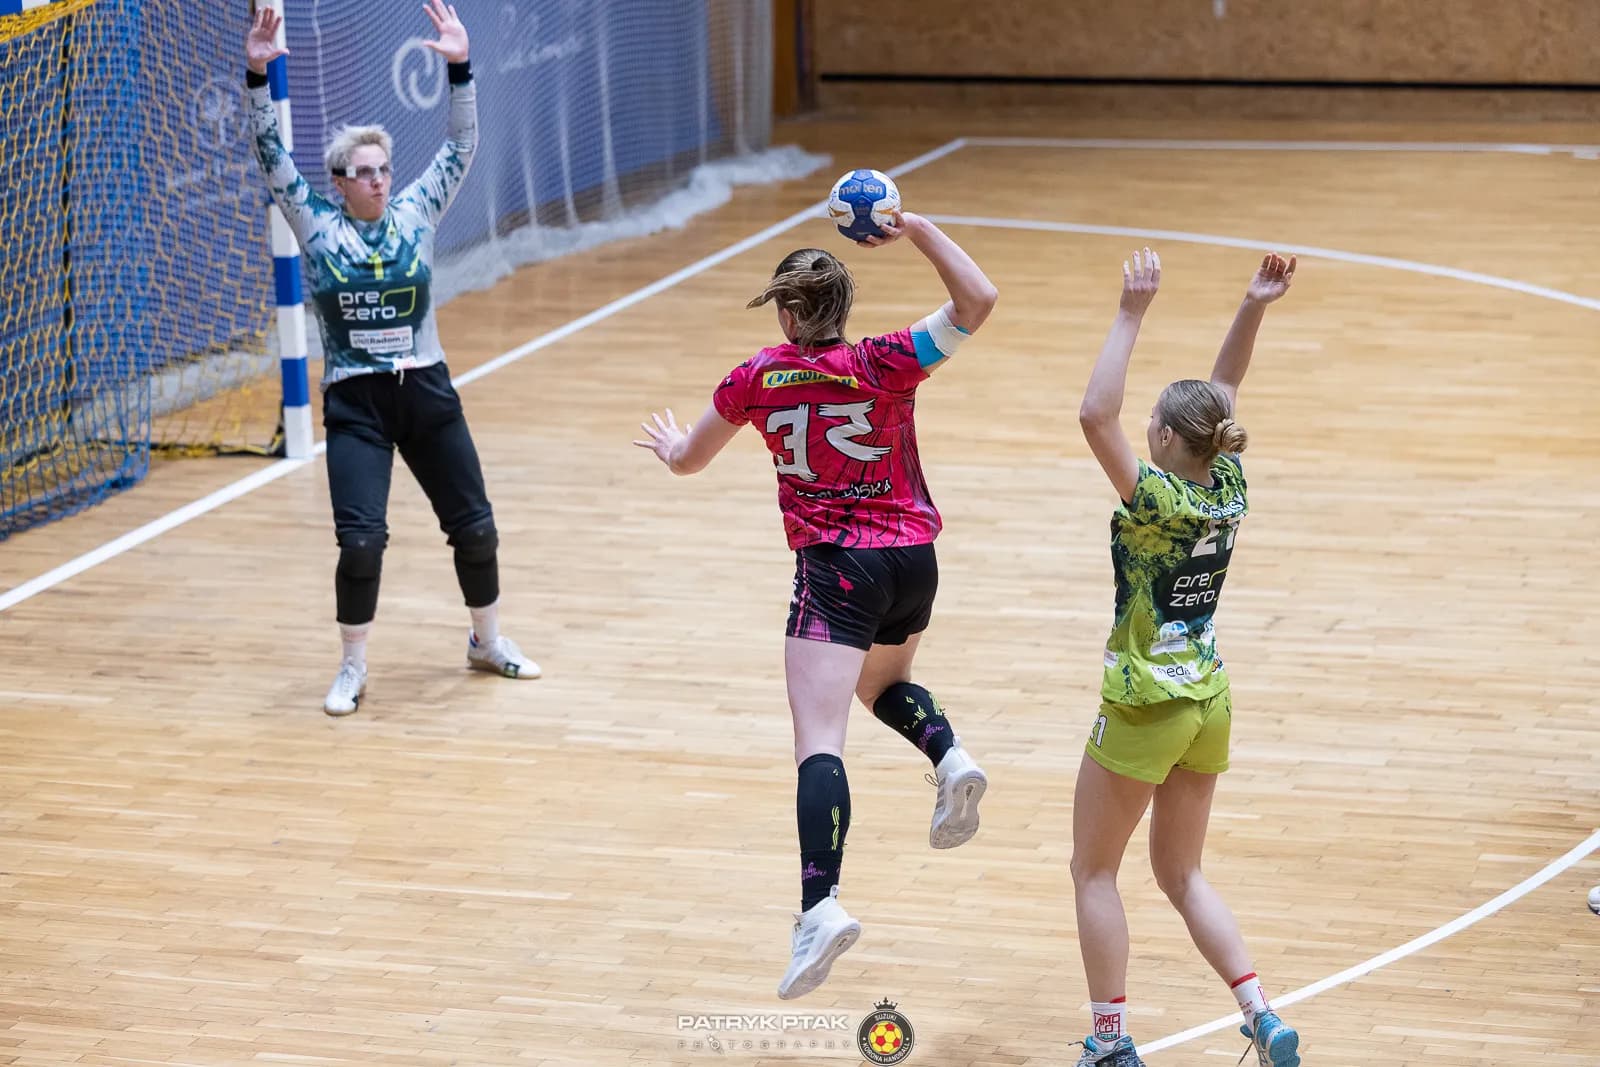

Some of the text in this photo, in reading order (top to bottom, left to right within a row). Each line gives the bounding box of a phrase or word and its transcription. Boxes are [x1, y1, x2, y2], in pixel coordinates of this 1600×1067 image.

[840, 184, 883, 196] molten
[338, 291, 380, 307] pre
[341, 305, 397, 320] zero
[1173, 573, 1210, 591] pre
[1169, 590, 1216, 607] zero
